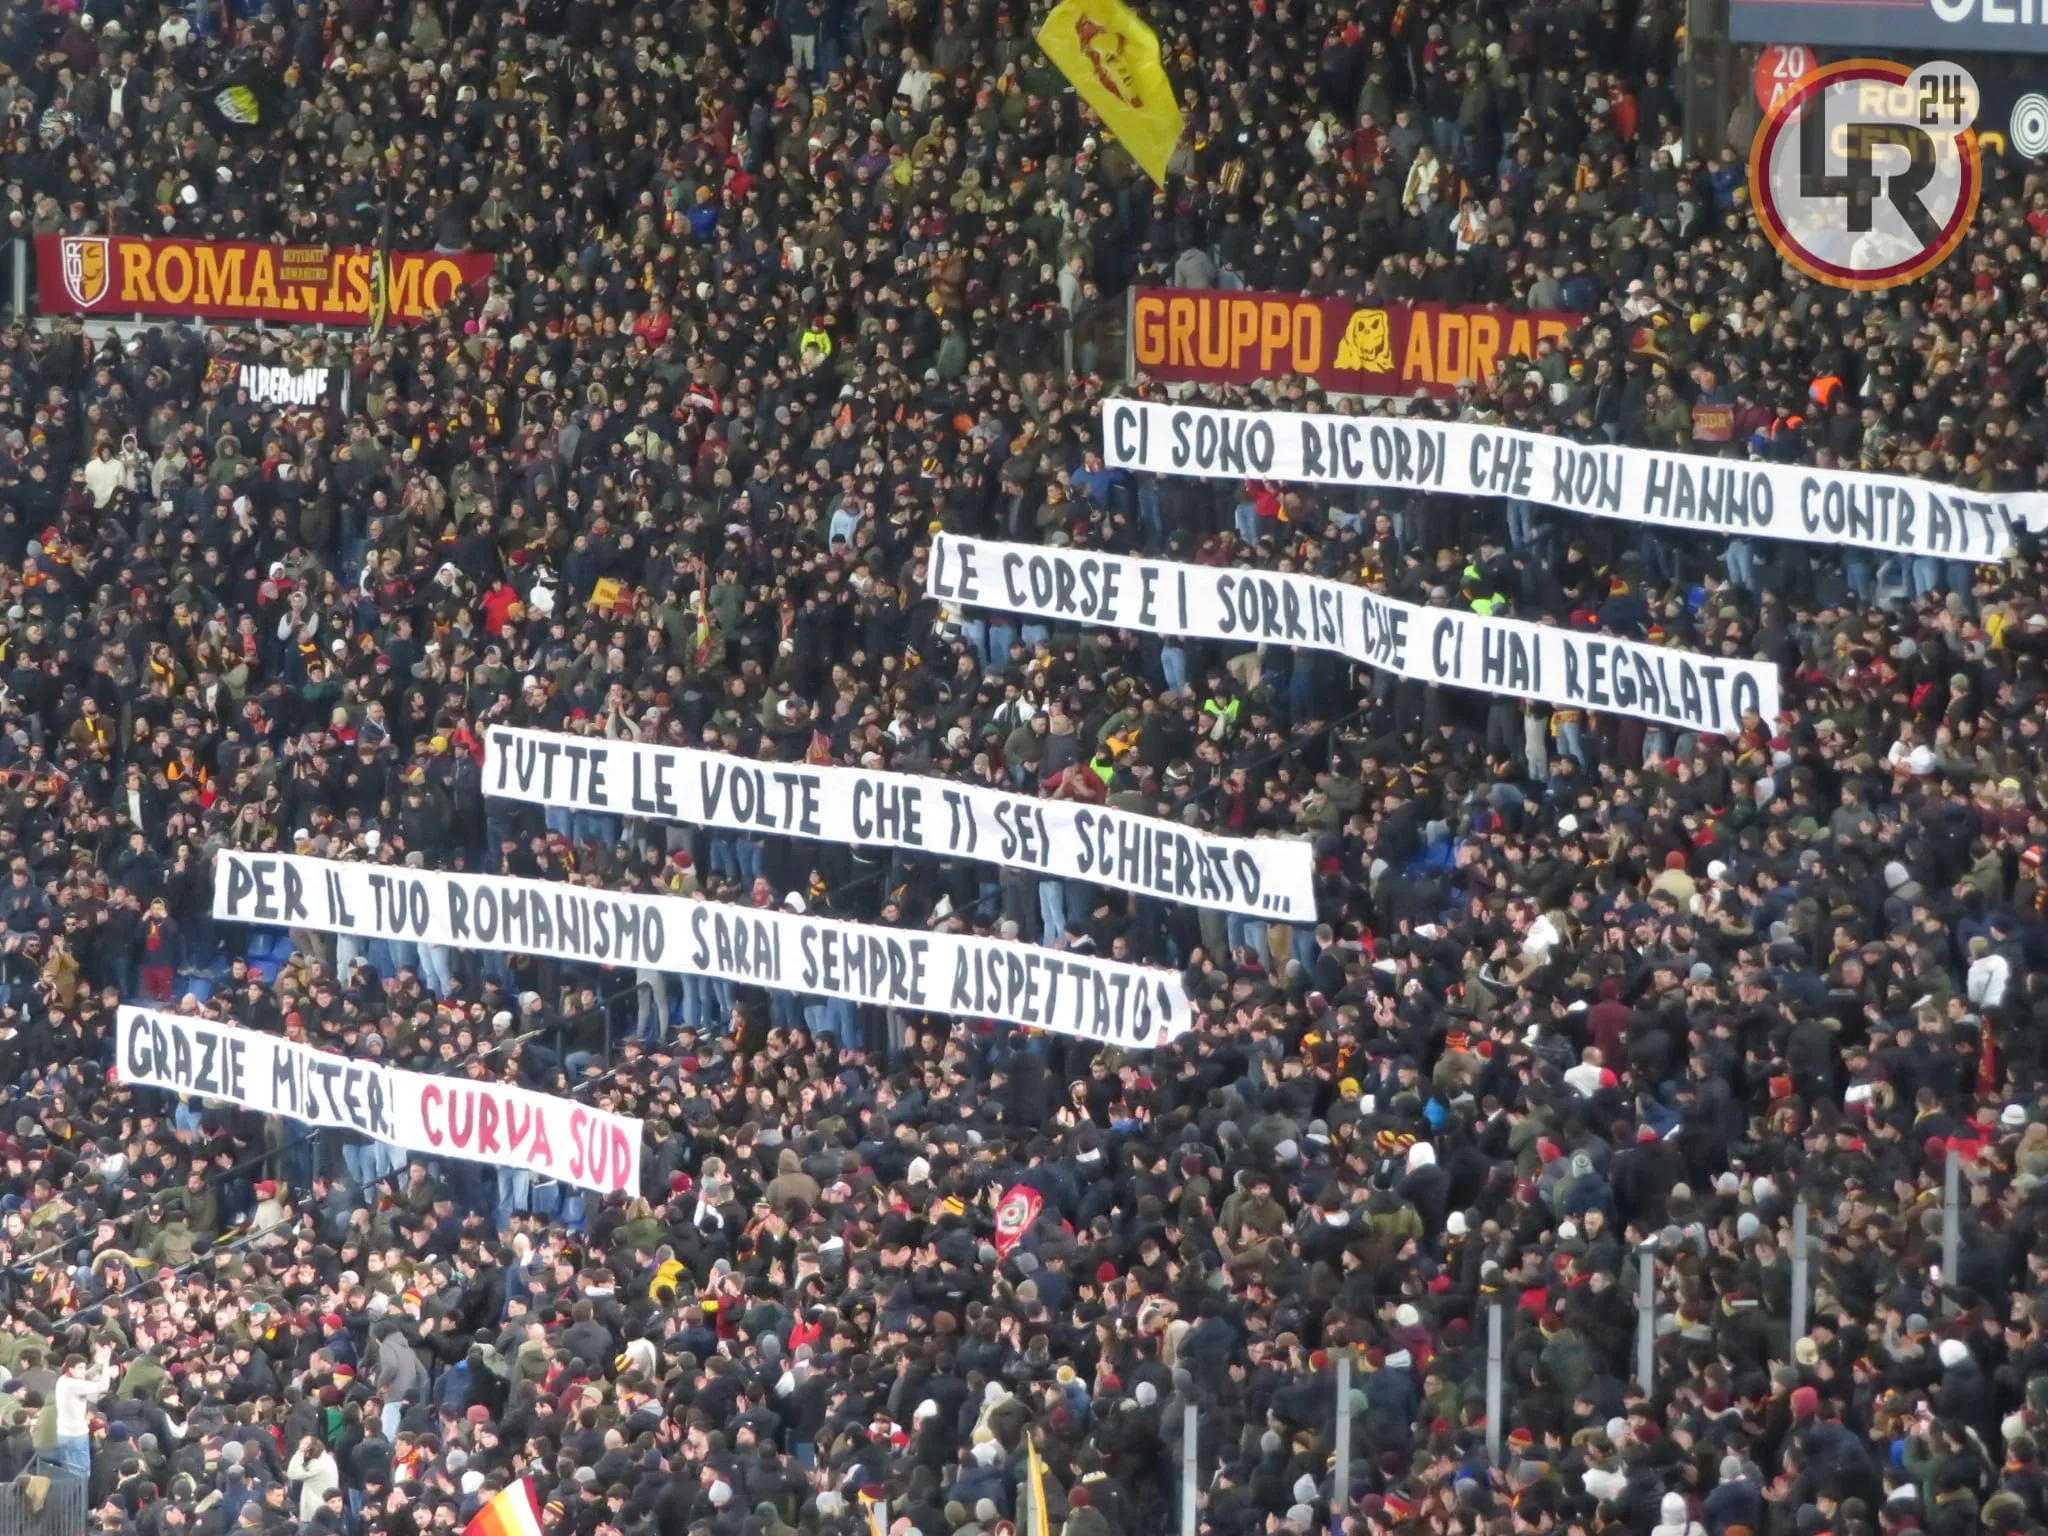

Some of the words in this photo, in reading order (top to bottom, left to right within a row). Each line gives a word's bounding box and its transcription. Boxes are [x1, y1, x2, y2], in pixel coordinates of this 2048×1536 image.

[1773, 46, 1804, 78] 20
[1134, 296, 1322, 373] GRUPPO
[1114, 406, 1148, 465] CI
[1171, 411, 1275, 474] SONO
[1301, 421, 1446, 486] RICORDI
[1470, 433, 1533, 497] CHE
[1552, 446, 1623, 512] NON
[1643, 458, 1774, 526] HANNO
[934, 536, 979, 600] LE
[1003, 552, 1121, 621] CORSE
[1139, 567, 1159, 626] E
[1178, 570, 1188, 629] I
[1216, 574, 1346, 648] SORRISI
[1362, 596, 1408, 670] CHE
[1433, 616, 1464, 679] CI
[1482, 626, 1541, 692] HAI
[1563, 639, 1760, 731] REGALATO
[493, 732, 608, 806] TUTTE
[632, 752, 677, 816] LE
[701, 761, 821, 836] VOLTE
[853, 778, 923, 845] CHE
[942, 790, 977, 853] TI
[994, 800, 1049, 867] SEI
[1074, 808, 1291, 914] SCHIERATO...
[227, 856, 309, 921] PER
[325, 868, 355, 927] IL
[368, 873, 430, 937] TUO
[447, 880, 665, 963] ROMANISMO
[691, 905, 781, 981] SARAI
[800, 924, 929, 1005] SEMPRE
[128, 1013, 246, 1101] GRAZIE
[272, 1044, 395, 1140] MISTER!
[421, 1084, 553, 1167] CURVA
[569, 1108, 631, 1190] SUD
